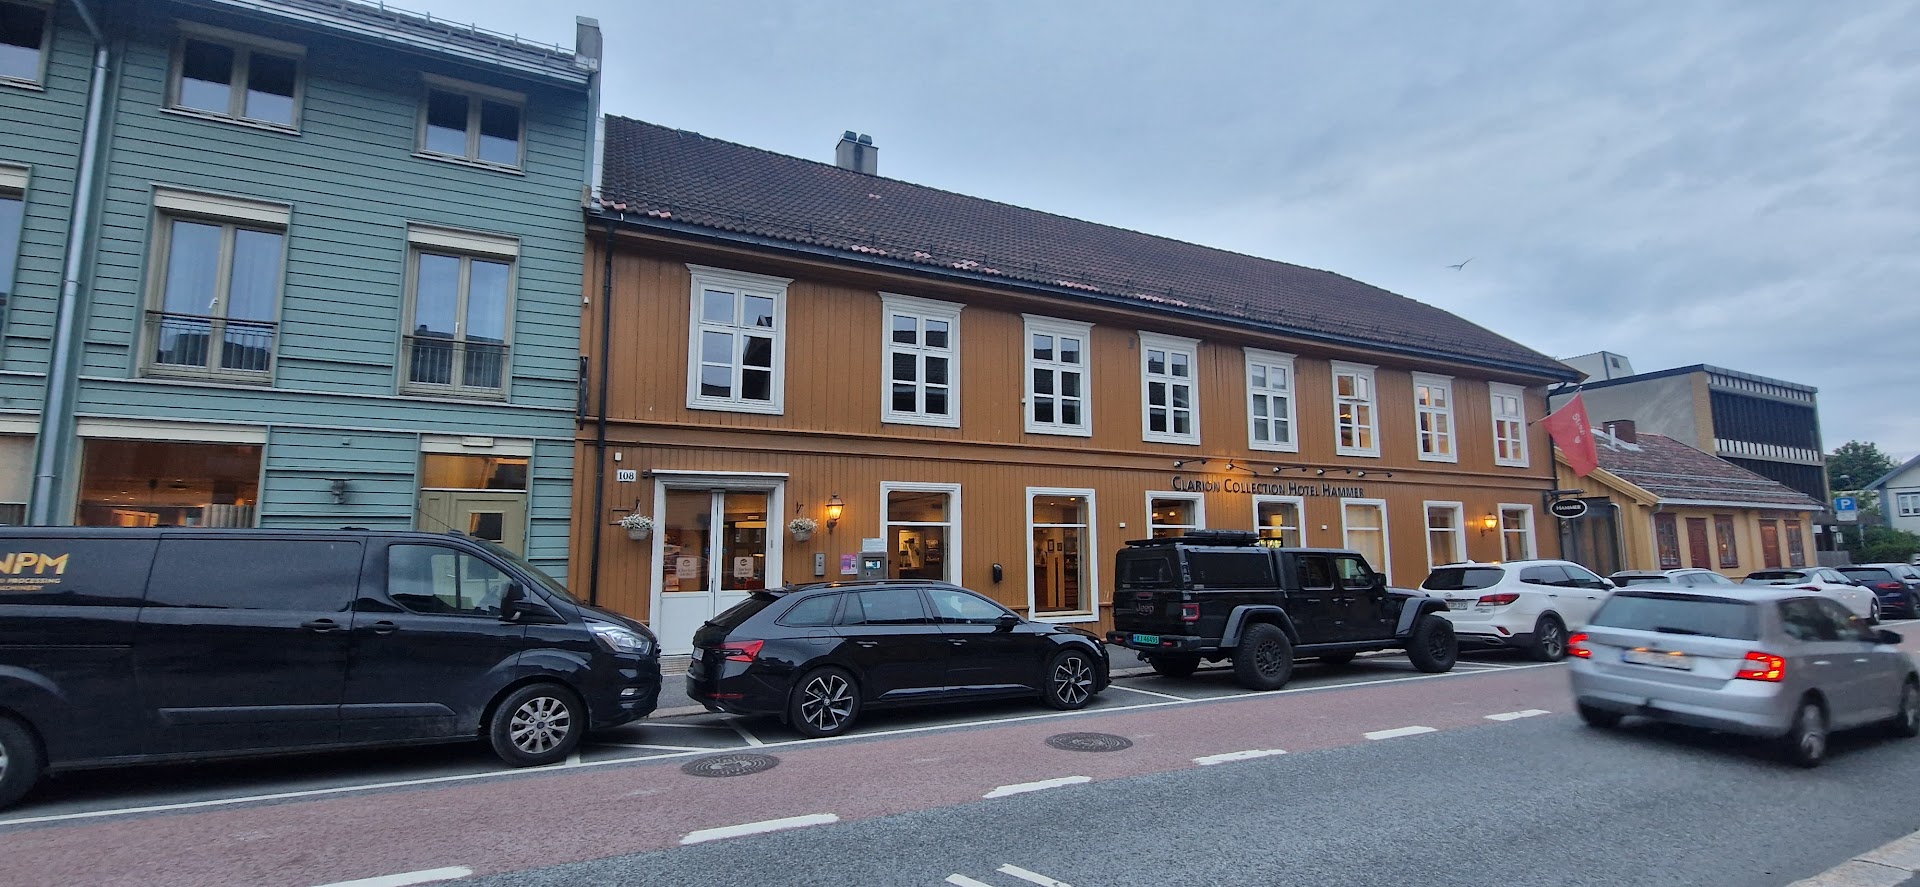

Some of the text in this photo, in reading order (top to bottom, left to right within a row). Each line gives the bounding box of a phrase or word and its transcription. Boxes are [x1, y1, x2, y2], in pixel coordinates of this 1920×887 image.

[619, 471, 634, 480] 108
[1224, 479, 1285, 495] COLLECTION
[1288, 482, 1319, 497] HOTEL
[1322, 483, 1364, 498] HAMMER
[1840, 499, 1852, 510] P
[1136, 603, 1155, 615] Jeep
